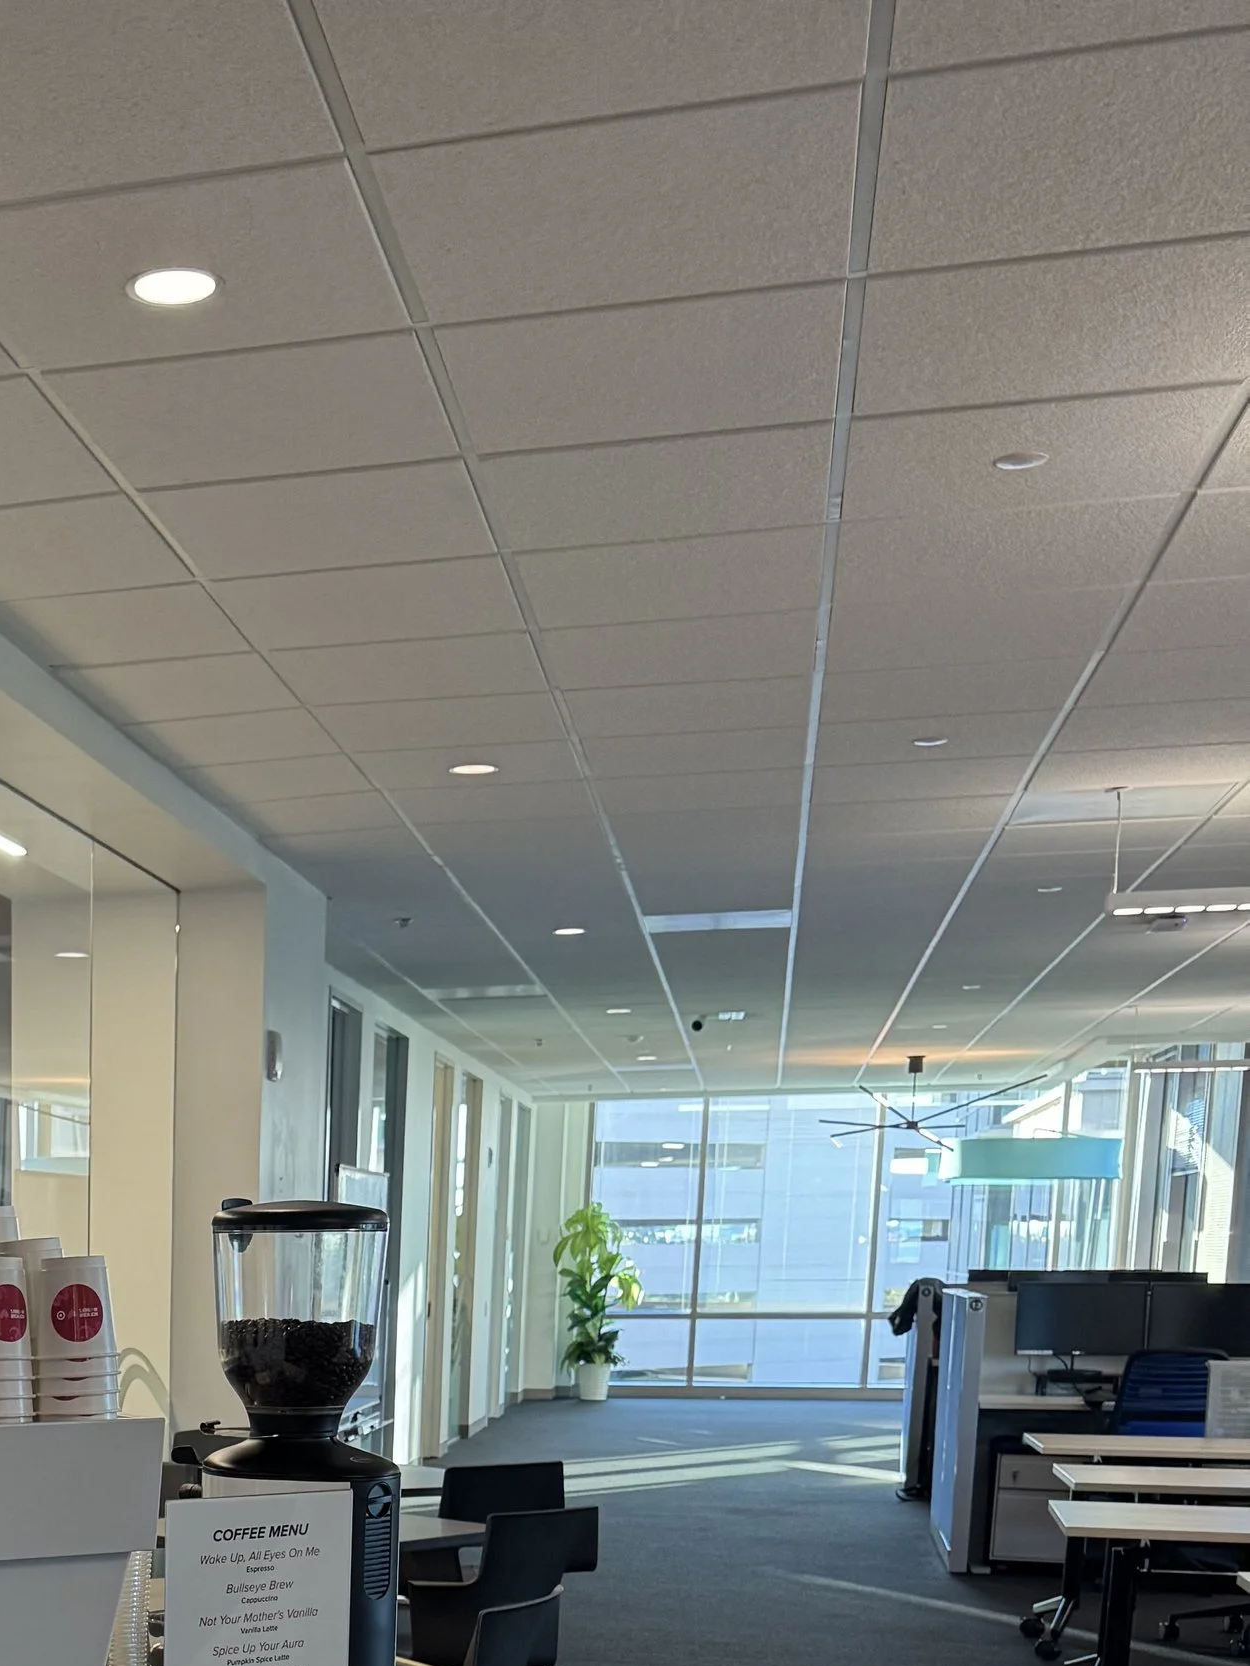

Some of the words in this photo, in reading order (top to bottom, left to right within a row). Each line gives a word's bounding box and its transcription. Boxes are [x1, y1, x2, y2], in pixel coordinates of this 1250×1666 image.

[213, 1526, 266, 1541] COFFEE
[269, 1523, 309, 1538] MENU
[200, 1553, 227, 1565] Wake
[230, 1552, 246, 1564] Up,
[248, 1550, 262, 1561] All
[264, 1549, 286, 1562] Eyes
[289, 1547, 303, 1558] On
[305, 1546, 320, 1557] Me
[246, 1565, 275, 1573] Espresso
[226, 1582, 267, 1594] Bullseye
[269, 1580, 294, 1590] Brew
[241, 1595, 278, 1604] Cappuccino
[199, 1617, 217, 1627] Not
[220, 1615, 241, 1625] Your
[243, 1610, 284, 1623] Mother's
[287, 1607, 318, 1619] Vanilla
[240, 1626, 261, 1634] Vanilla
[262, 1625, 278, 1633] Latte
[212, 1646, 239, 1657] Spice
[242, 1644, 256, 1654] Up
[259, 1641, 280, 1652] Your
[281, 1639, 304, 1650] Aura
[227, 1658, 254, 1666] Pumpkin
[255, 1656, 273, 1664] Spice
[274, 1654, 290, 1662] Latte
